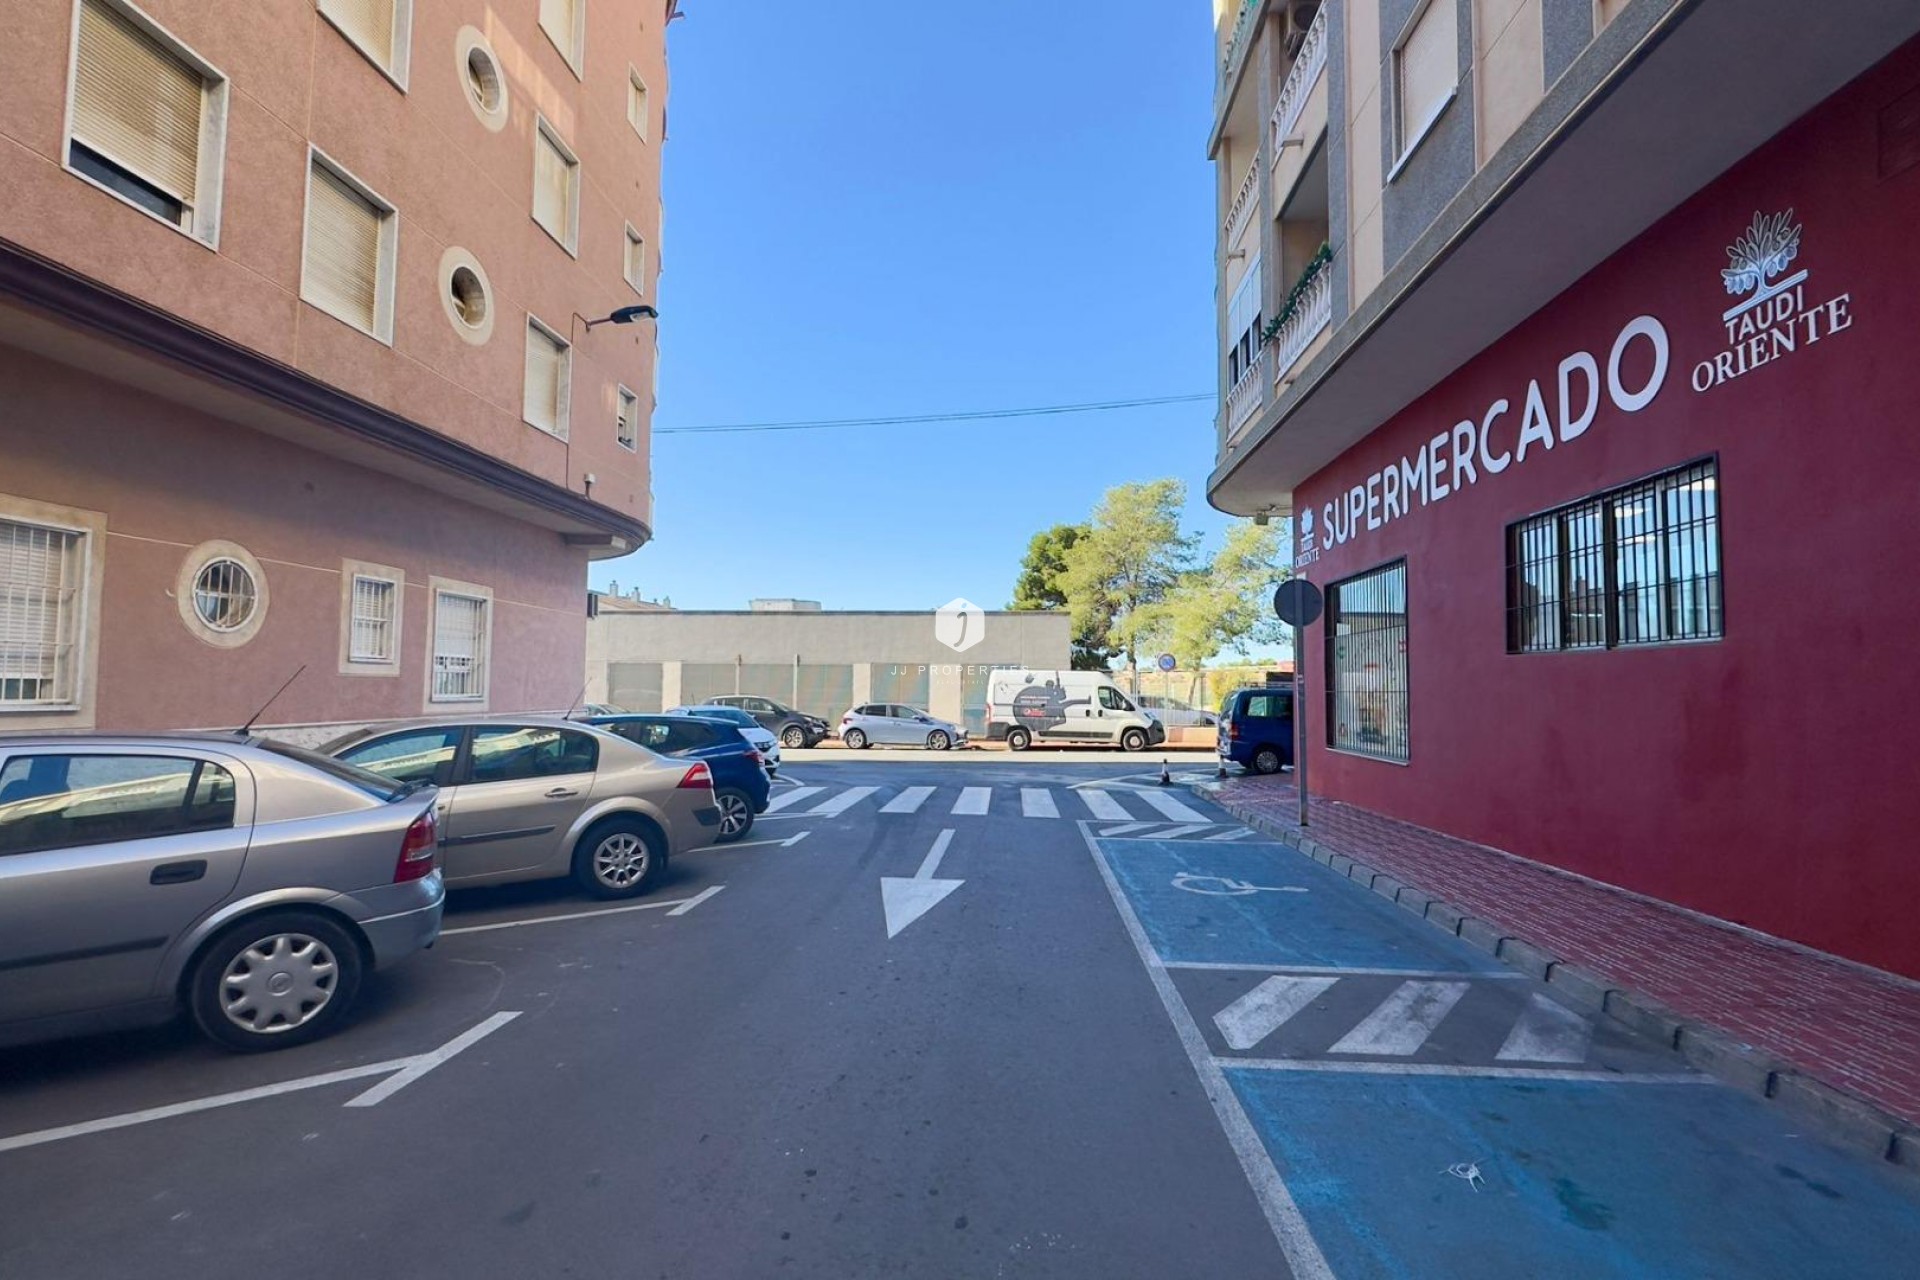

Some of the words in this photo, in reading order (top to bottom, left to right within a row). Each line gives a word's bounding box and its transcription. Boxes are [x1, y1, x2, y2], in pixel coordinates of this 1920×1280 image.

[1692, 292, 1853, 393] ORIENTE
[1725, 285, 1804, 345] TAUDI
[1322, 314, 1670, 551] SUPERMERCADO
